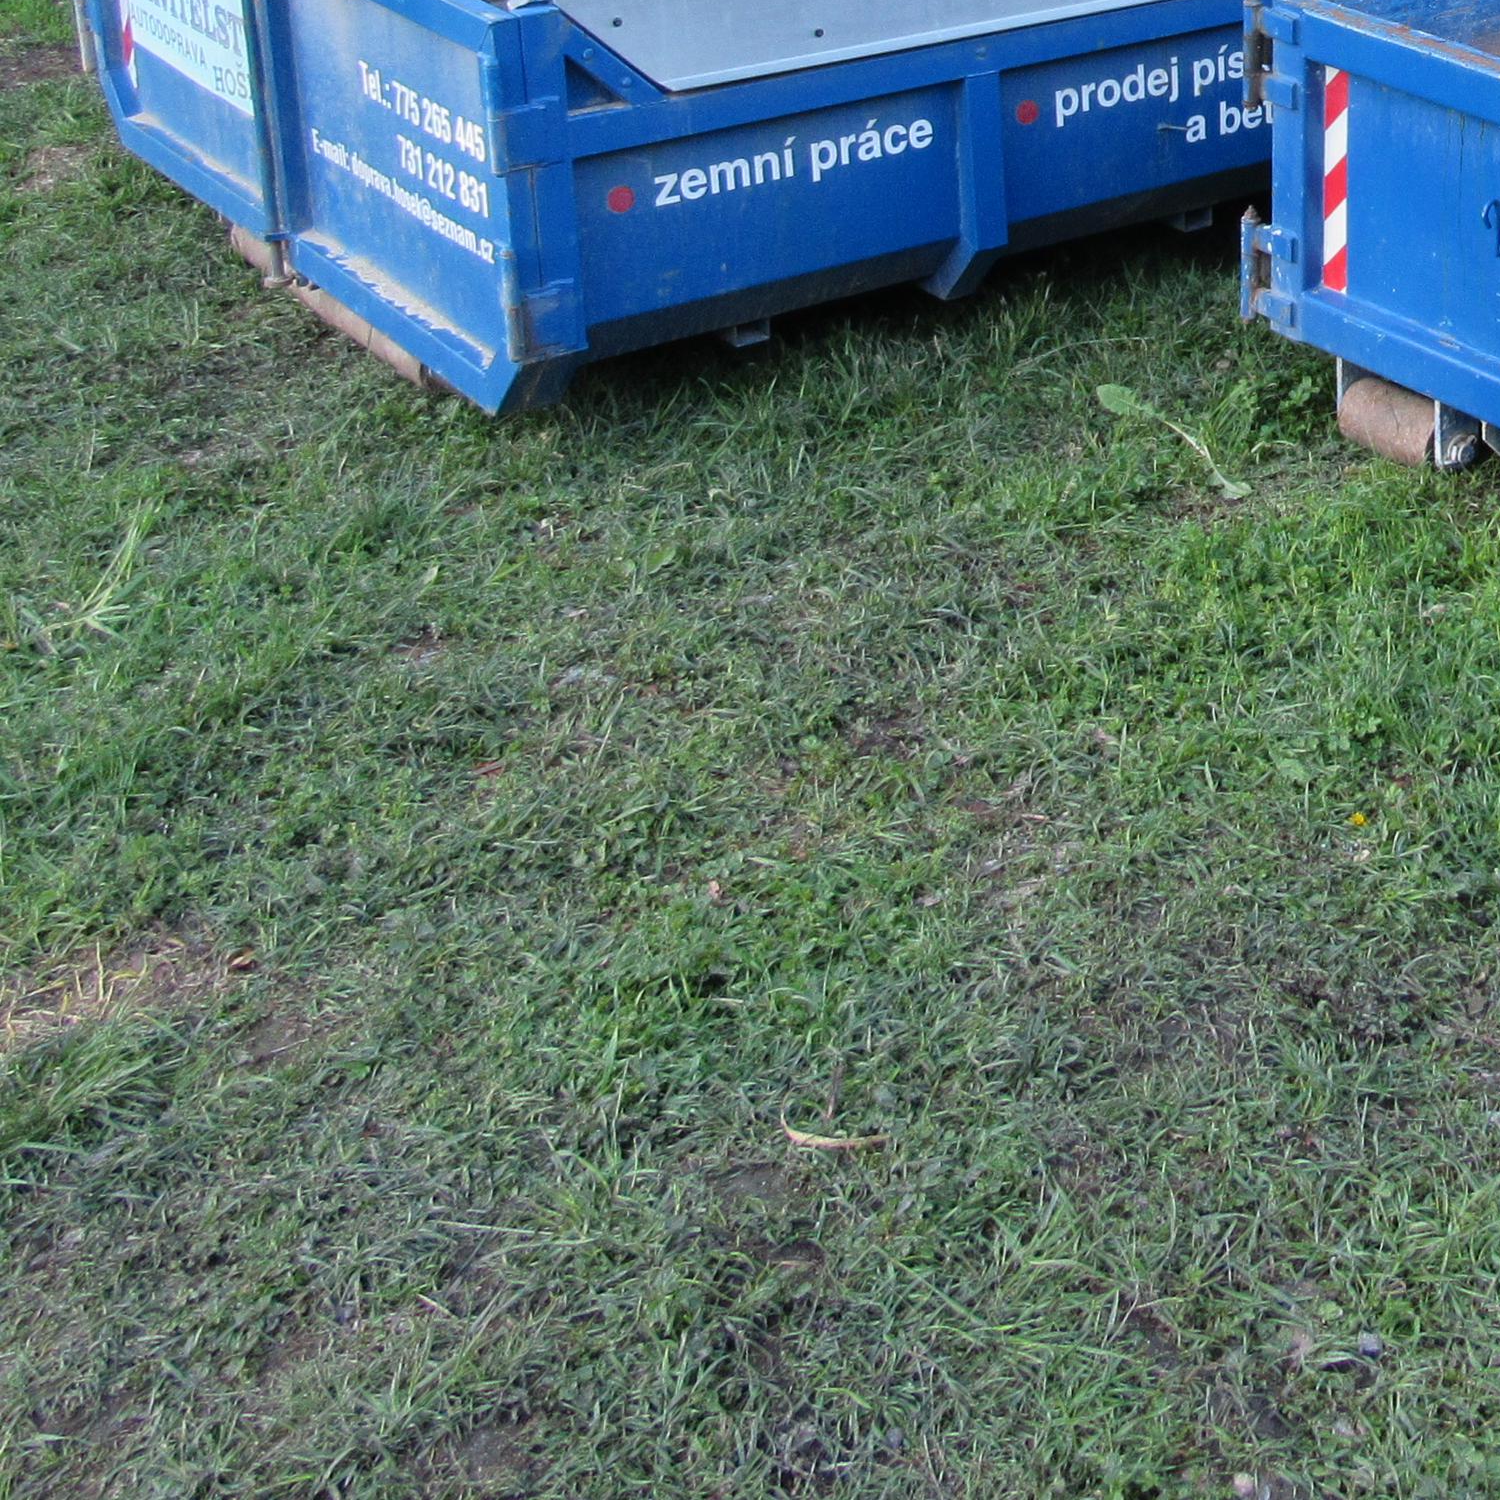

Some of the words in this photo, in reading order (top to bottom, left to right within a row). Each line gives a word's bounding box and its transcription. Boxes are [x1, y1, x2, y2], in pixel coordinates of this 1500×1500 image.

[130, 3, 206, 69] AUTODOPRAVA
[213, 61, 251, 99] HOŠ
[358, 60, 392, 109] Tel.:
[392, 80, 420, 126] 775
[422, 98, 451, 144] 265
[455, 116, 486, 162] 445
[1055, 56, 1179, 128] prodej
[1193, 44, 1244, 97] pís
[312, 128, 350, 171] E-mail:
[654, 136, 796, 207] zemní
[810, 118, 934, 182] práce
[1186, 114, 1207, 143] a
[397, 134, 424, 180] 731
[427, 152, 456, 200] 212
[459, 171, 489, 218] 831
